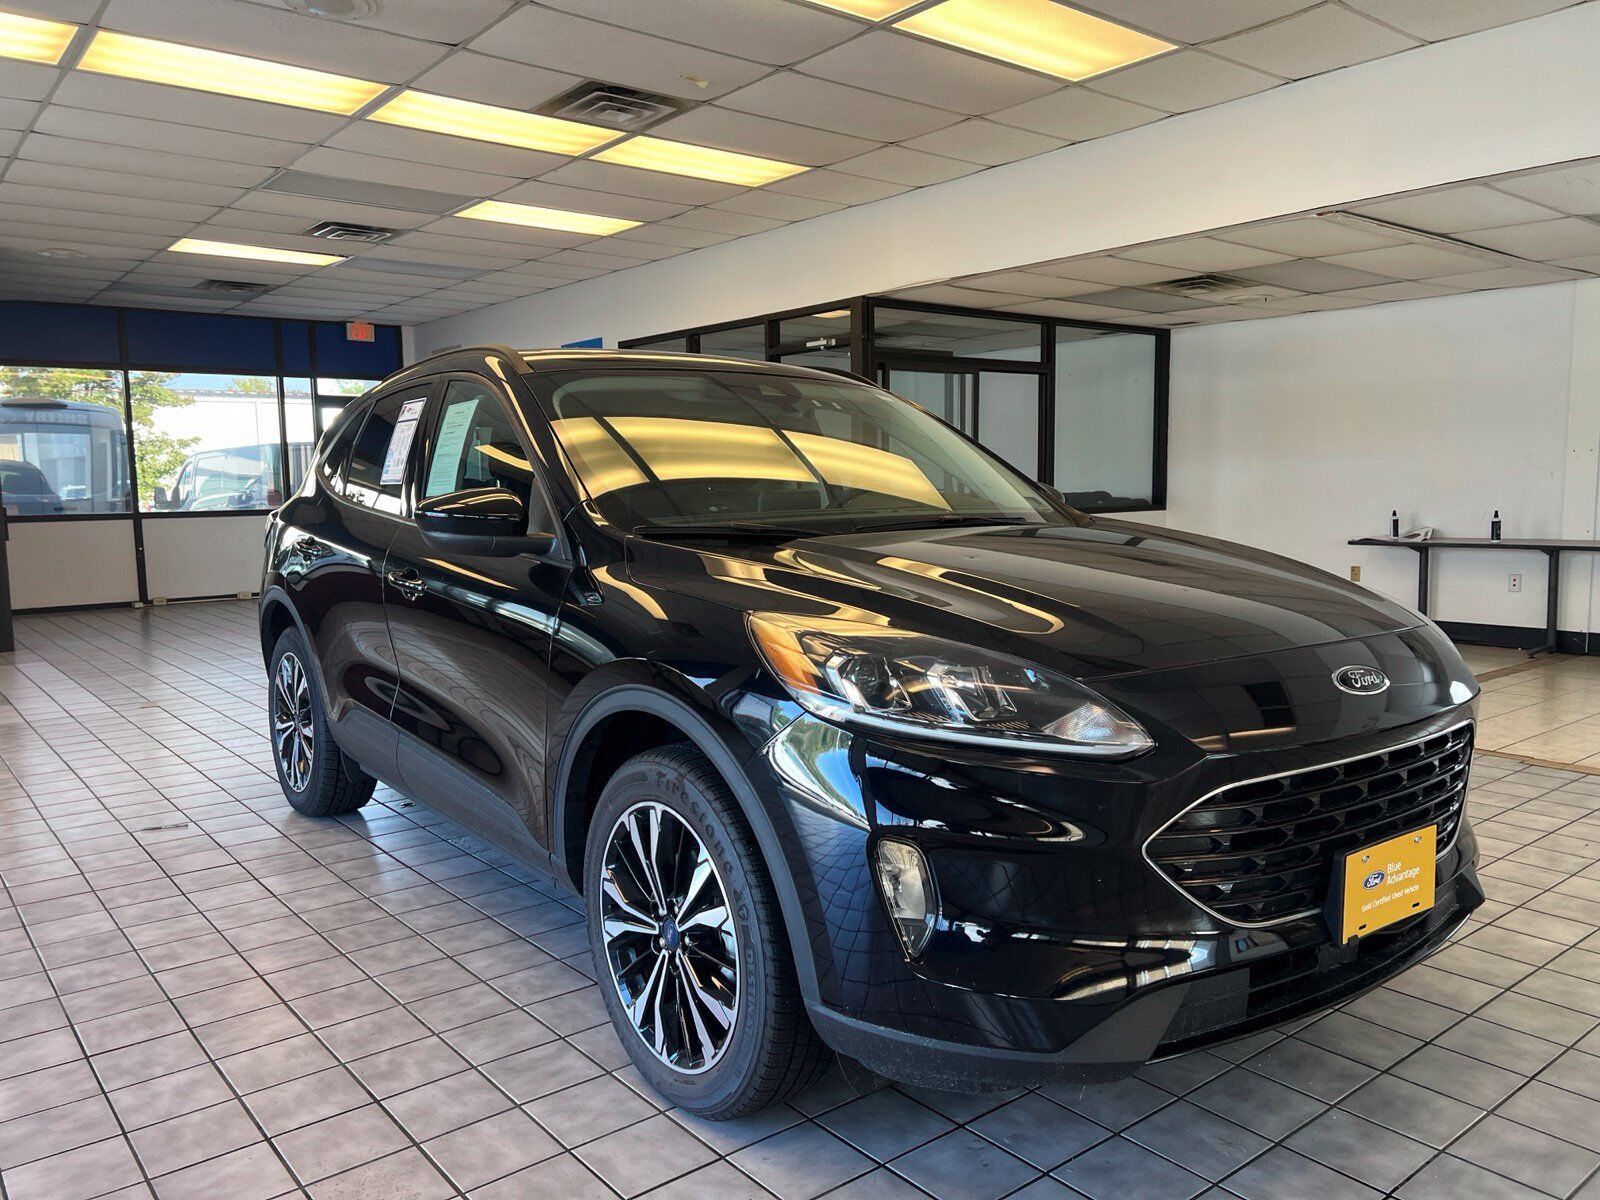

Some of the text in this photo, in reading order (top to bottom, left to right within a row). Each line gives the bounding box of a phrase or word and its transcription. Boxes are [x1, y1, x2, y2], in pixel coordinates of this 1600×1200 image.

[1347, 669, 1380, 688] Ford
[655, 770, 735, 876] Firestone
[1387, 862, 1401, 873] Blue
[1387, 867, 1420, 885] Advantage
[1361, 902, 1372, 912] Gold
[1391, 889, 1403, 899] Used
[1404, 885, 1419, 895] Vehicle
